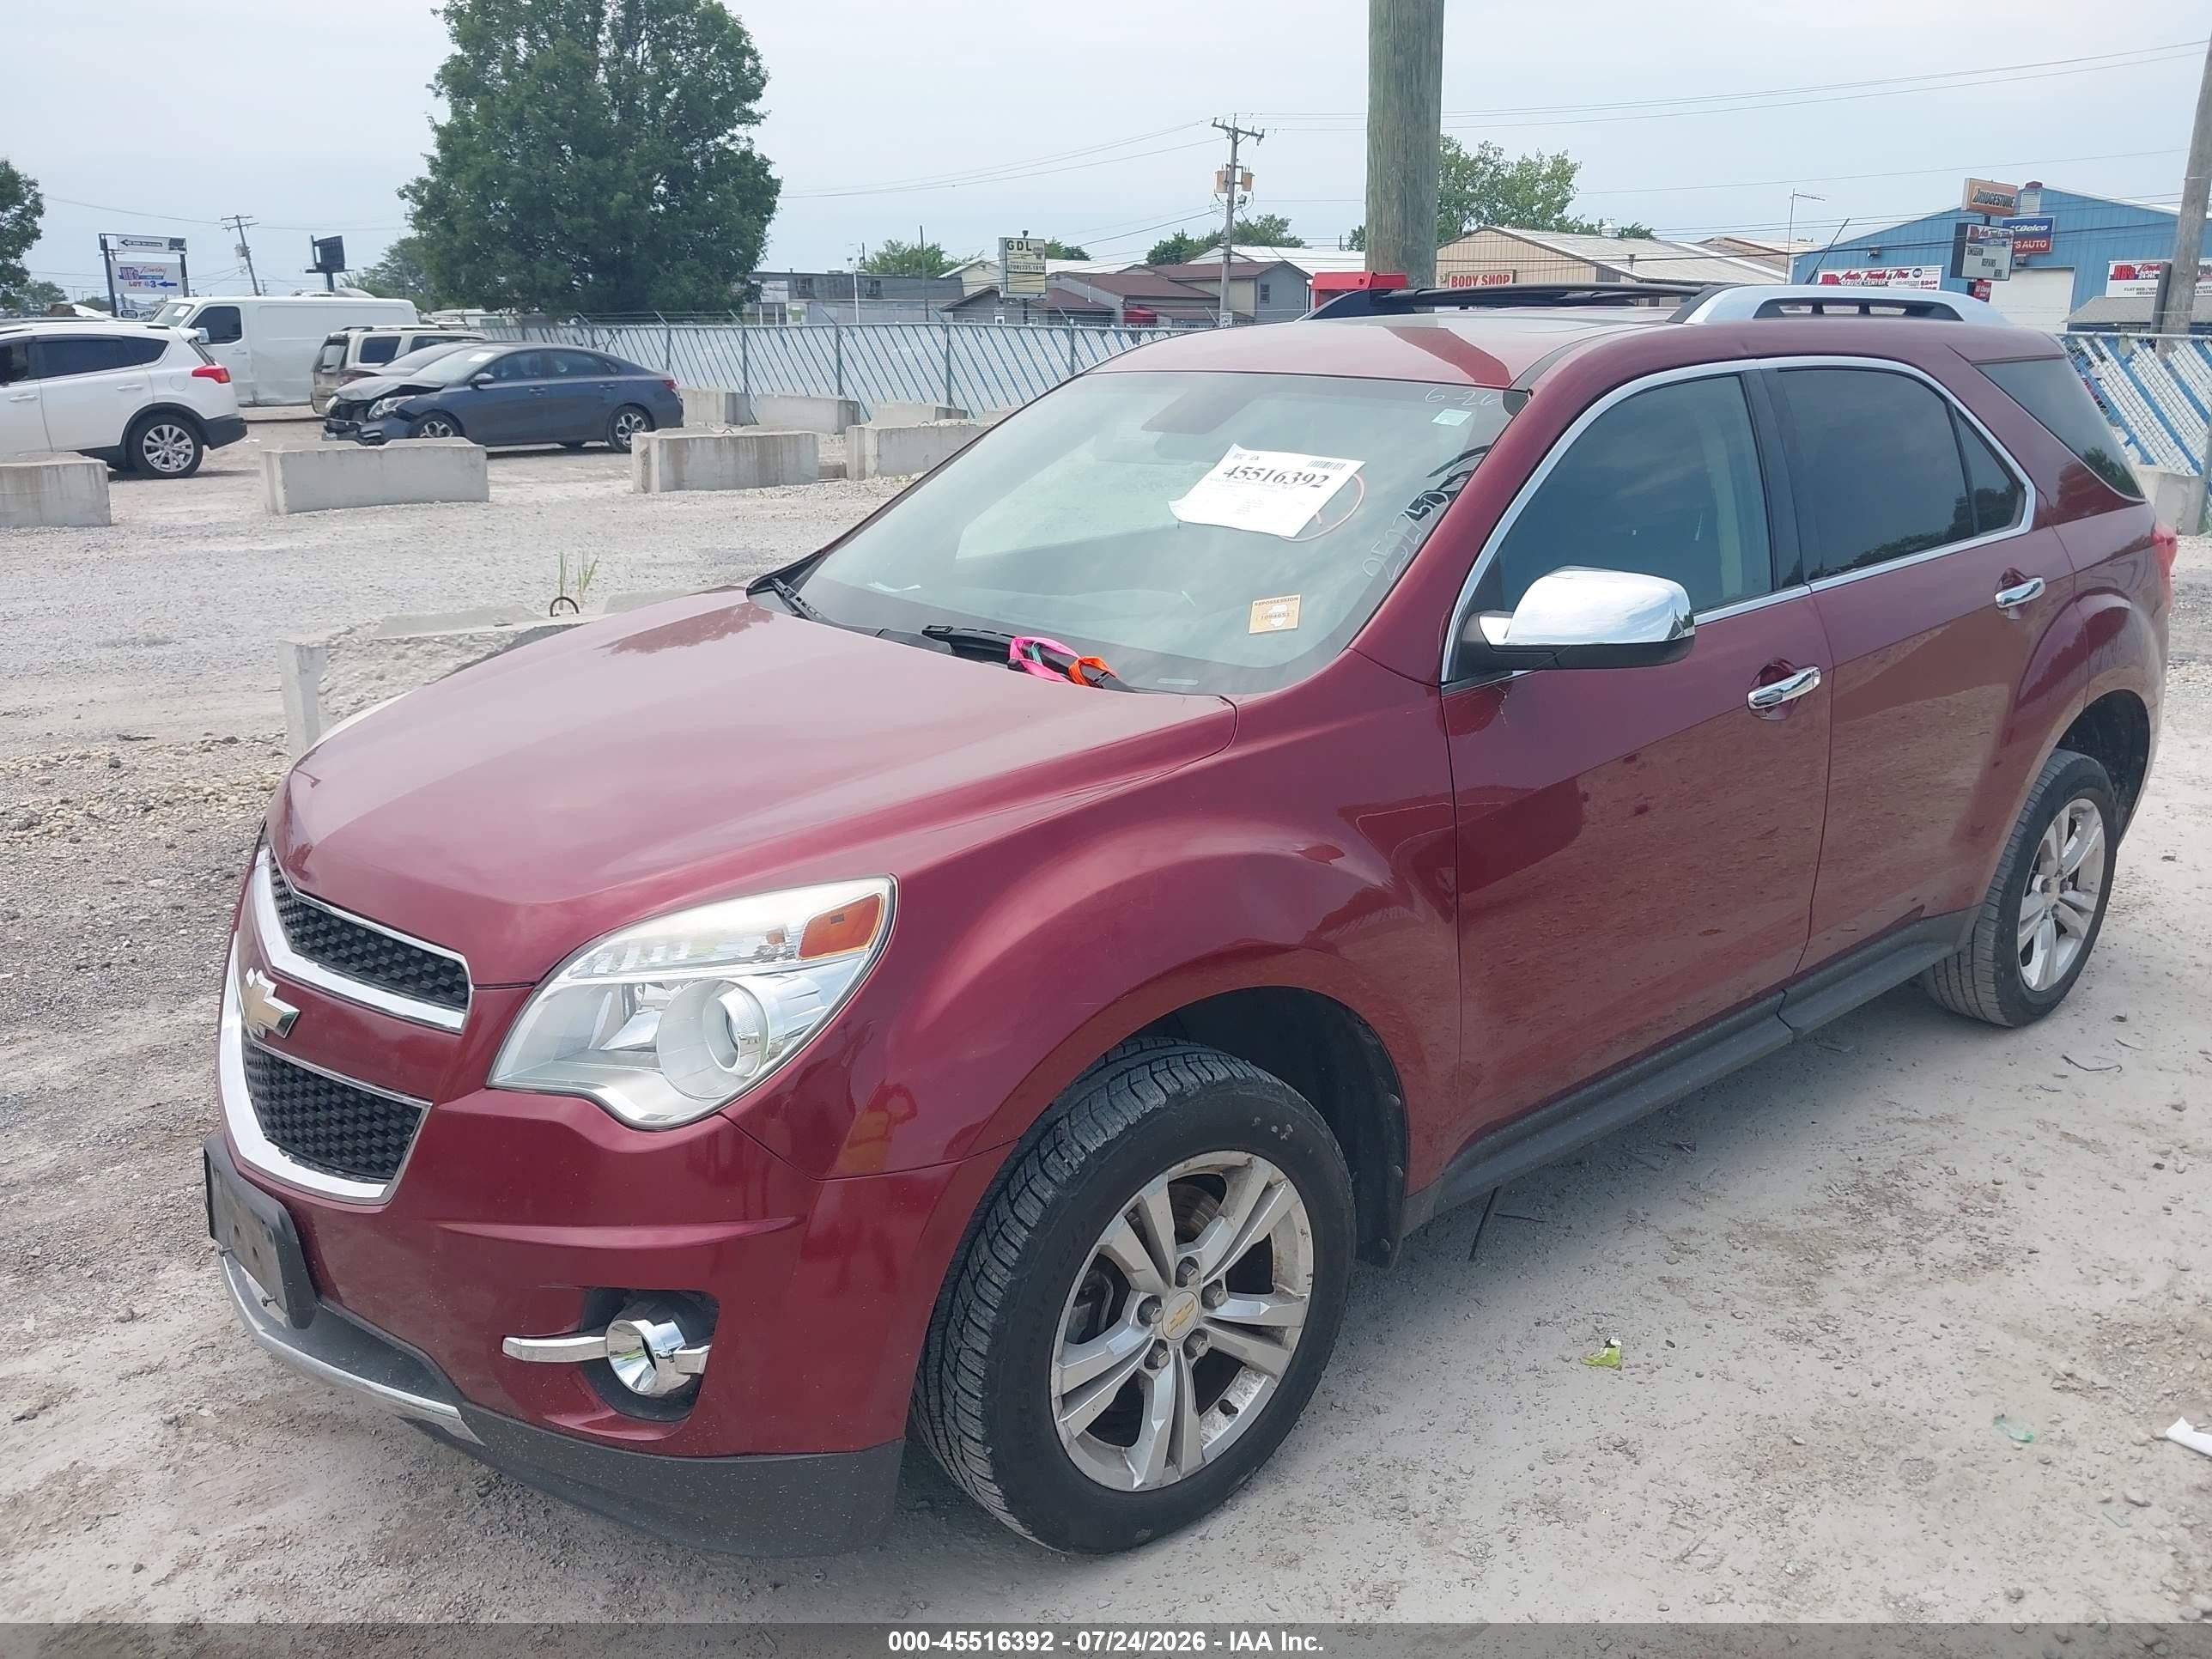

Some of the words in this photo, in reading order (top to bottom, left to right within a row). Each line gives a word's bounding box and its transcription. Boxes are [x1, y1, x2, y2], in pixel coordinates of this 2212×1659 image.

[1972, 188, 2015, 208] BRIDGESTONE
[1007, 240, 1031, 251] GDL
[1451, 275, 1479, 288] BODY
[1482, 274, 1510, 286] SHOP
[1224, 465, 1329, 489] 45516392
[1255, 597, 1298, 606] REPOSSESSION
